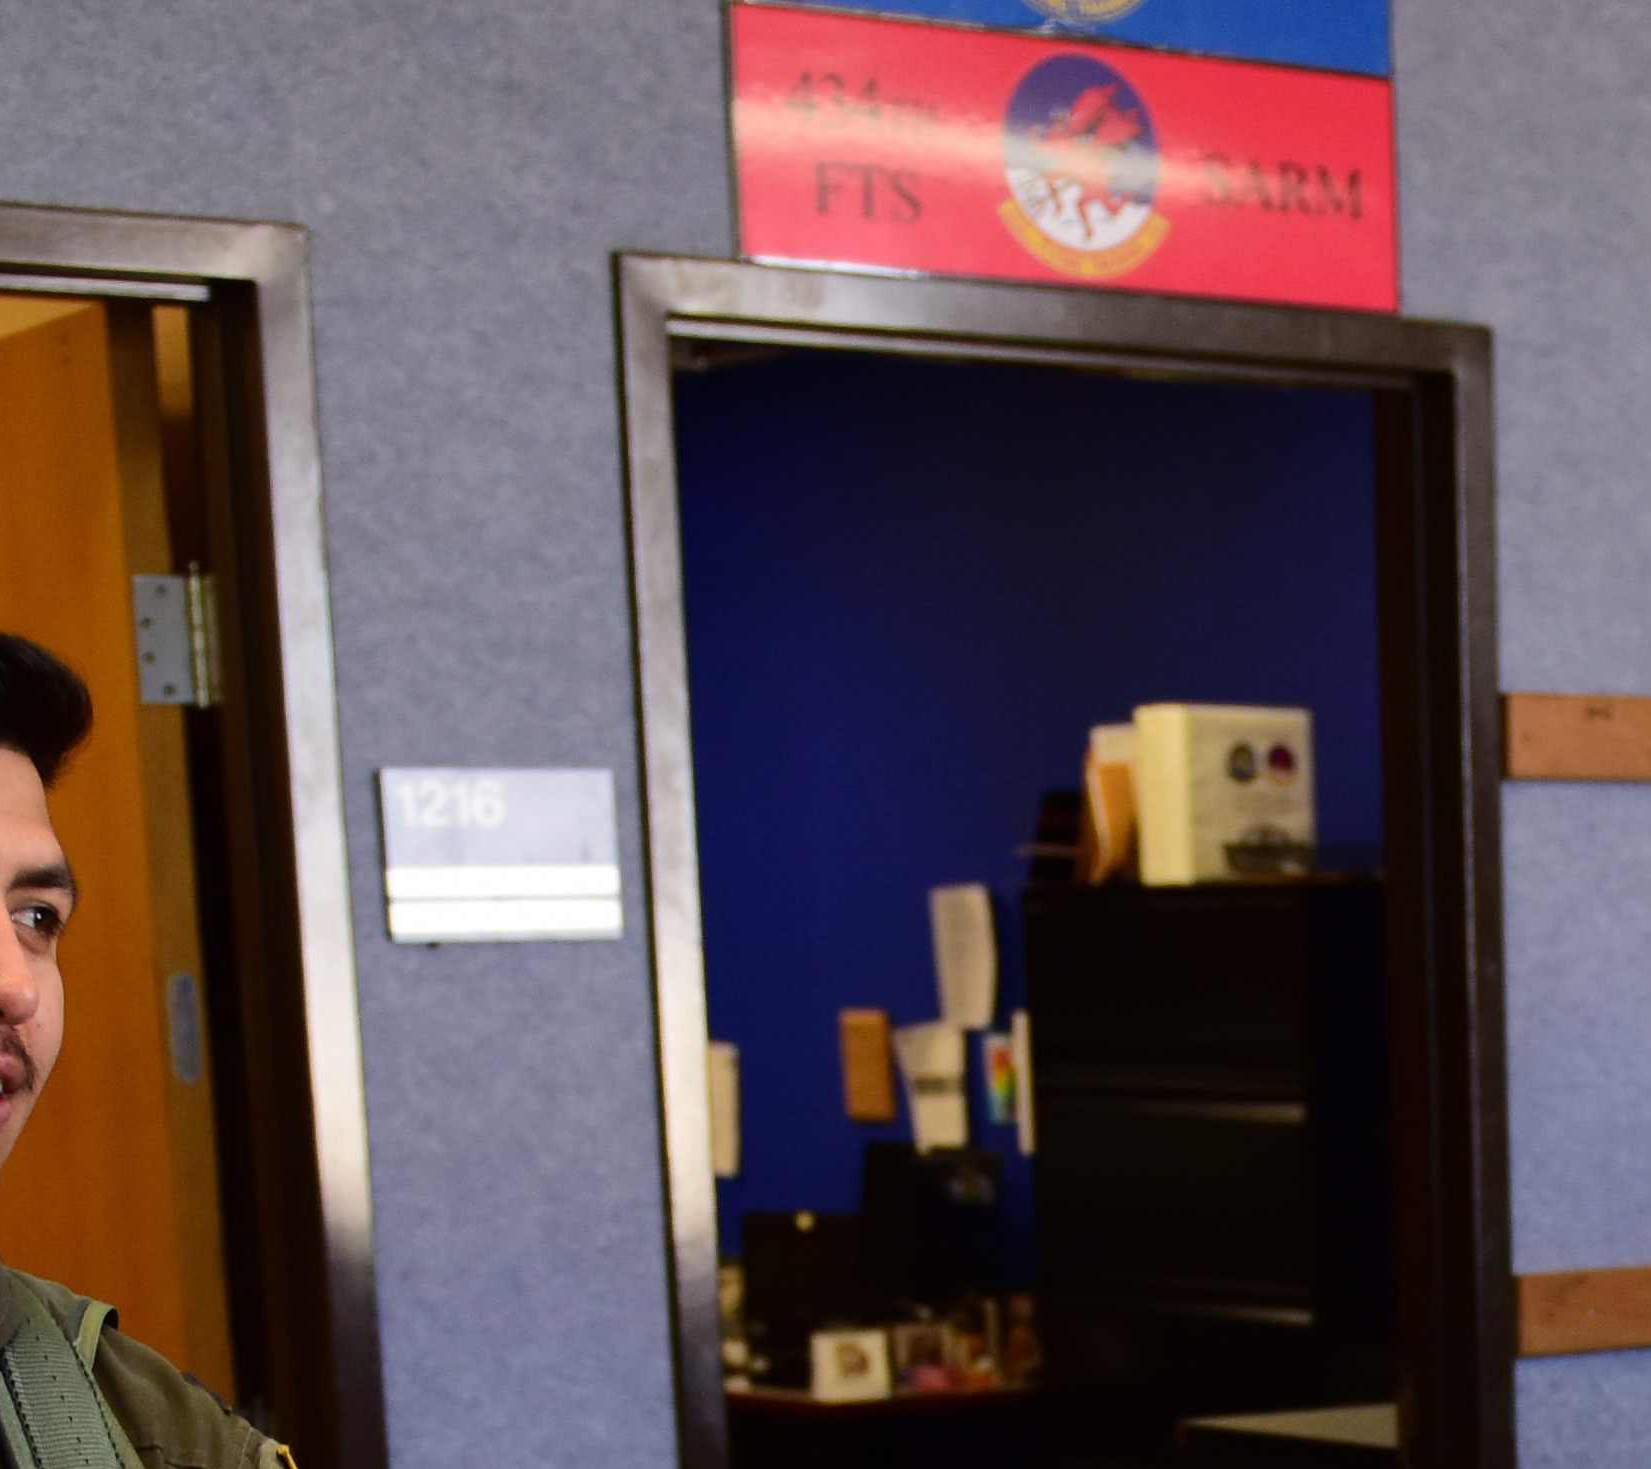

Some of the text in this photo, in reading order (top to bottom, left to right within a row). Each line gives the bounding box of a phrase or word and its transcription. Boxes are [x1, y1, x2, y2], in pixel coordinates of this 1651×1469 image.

[815, 160, 925, 226] FTS
[1198, 149, 1365, 220] SARM
[394, 779, 508, 829] 1216
